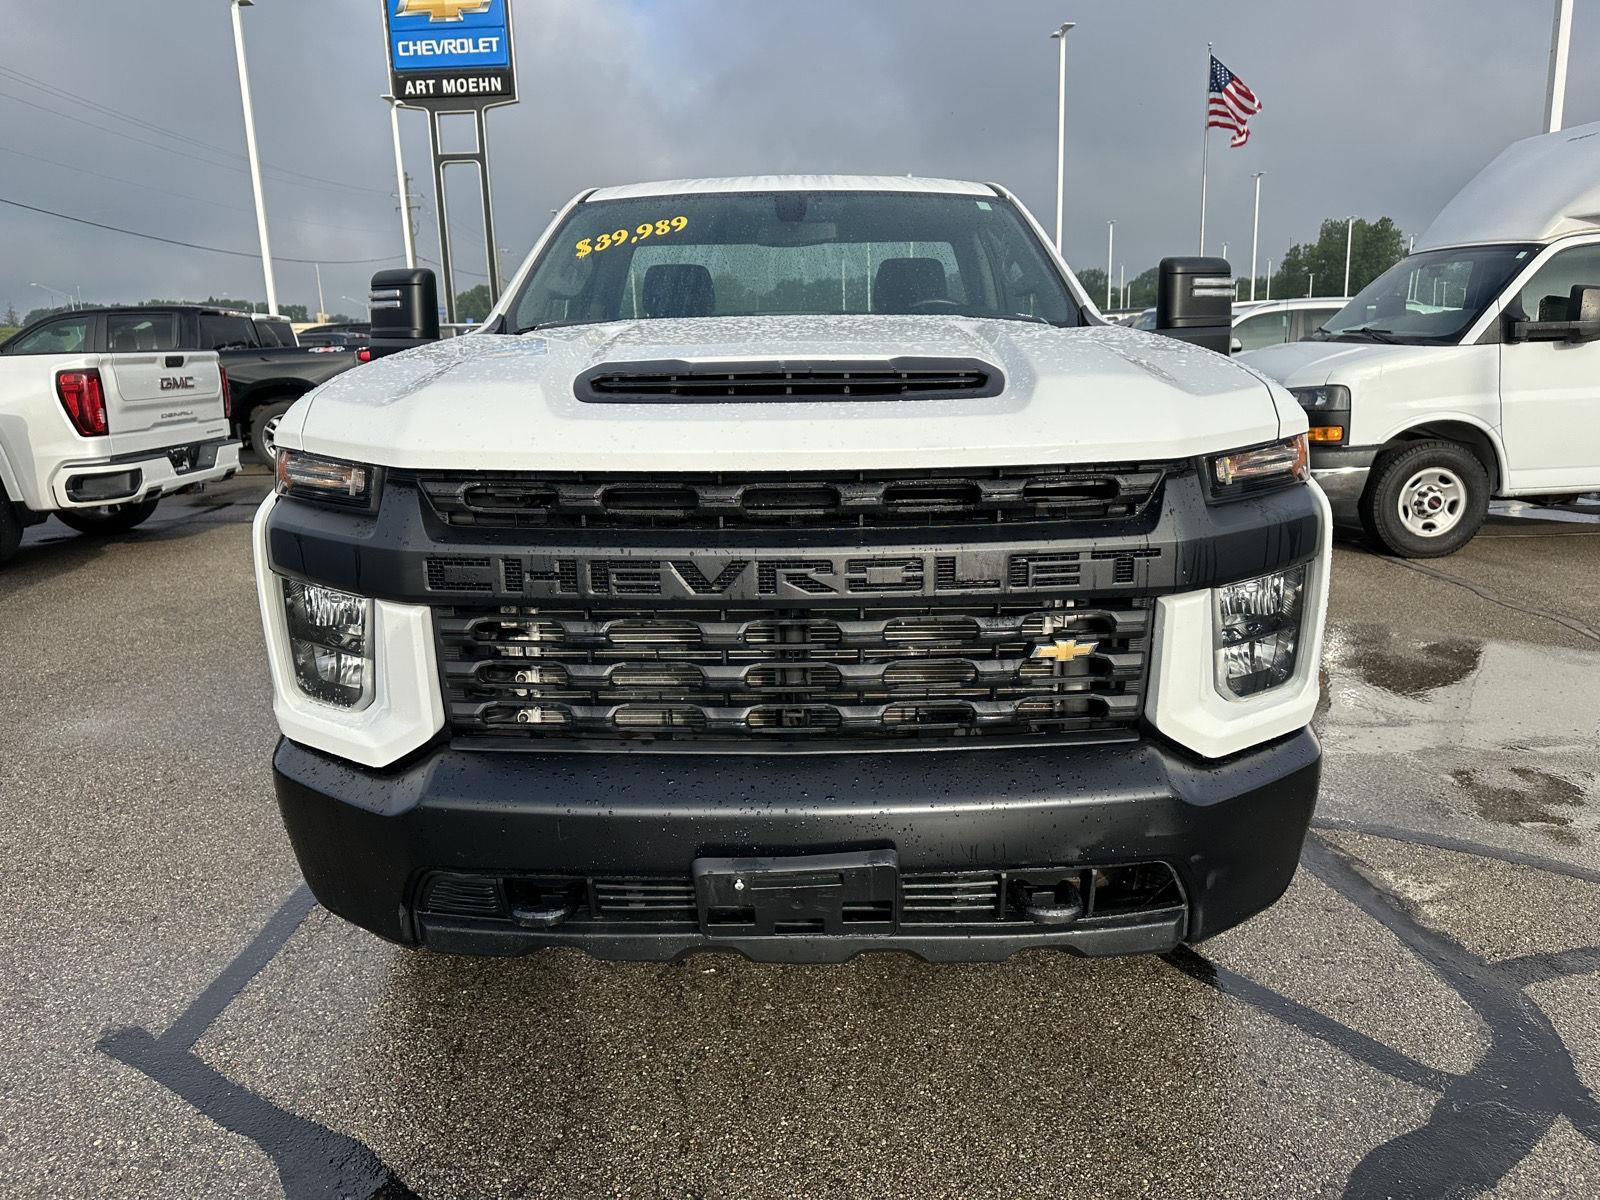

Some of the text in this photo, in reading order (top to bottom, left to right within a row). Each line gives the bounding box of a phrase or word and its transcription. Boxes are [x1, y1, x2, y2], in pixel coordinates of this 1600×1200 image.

[397, 37, 500, 56] CHEVROLET
[405, 77, 502, 95] ART MOEHN
[160, 376, 195, 390] GMC
[161, 411, 193, 419] DENALI
[423, 547, 1162, 596] CHEVROLET
